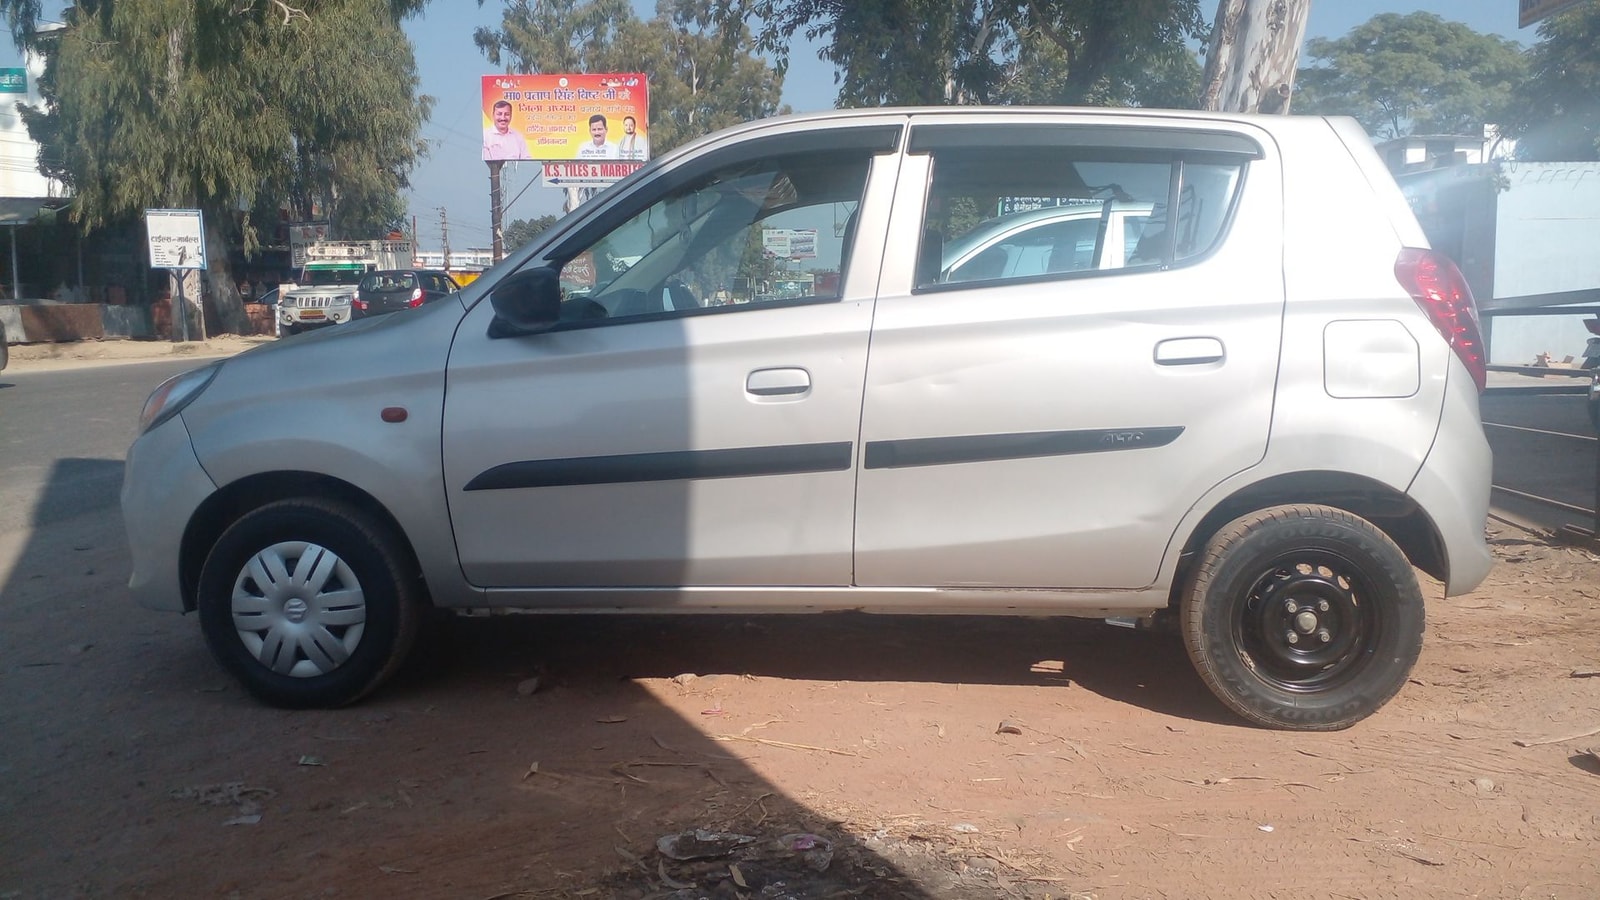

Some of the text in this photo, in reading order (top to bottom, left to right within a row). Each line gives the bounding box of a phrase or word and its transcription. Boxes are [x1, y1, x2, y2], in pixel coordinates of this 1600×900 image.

[524, 91, 551, 101] प्रताप
[554, 88, 575, 101] सिंह
[602, 89, 616, 100] जी
[518, 103, 543, 112] जिला
[547, 104, 576, 112] अध्यक्ष
[544, 163, 562, 177] K.S.
[564, 163, 589, 177] TILES
[591, 166, 598, 177] &
